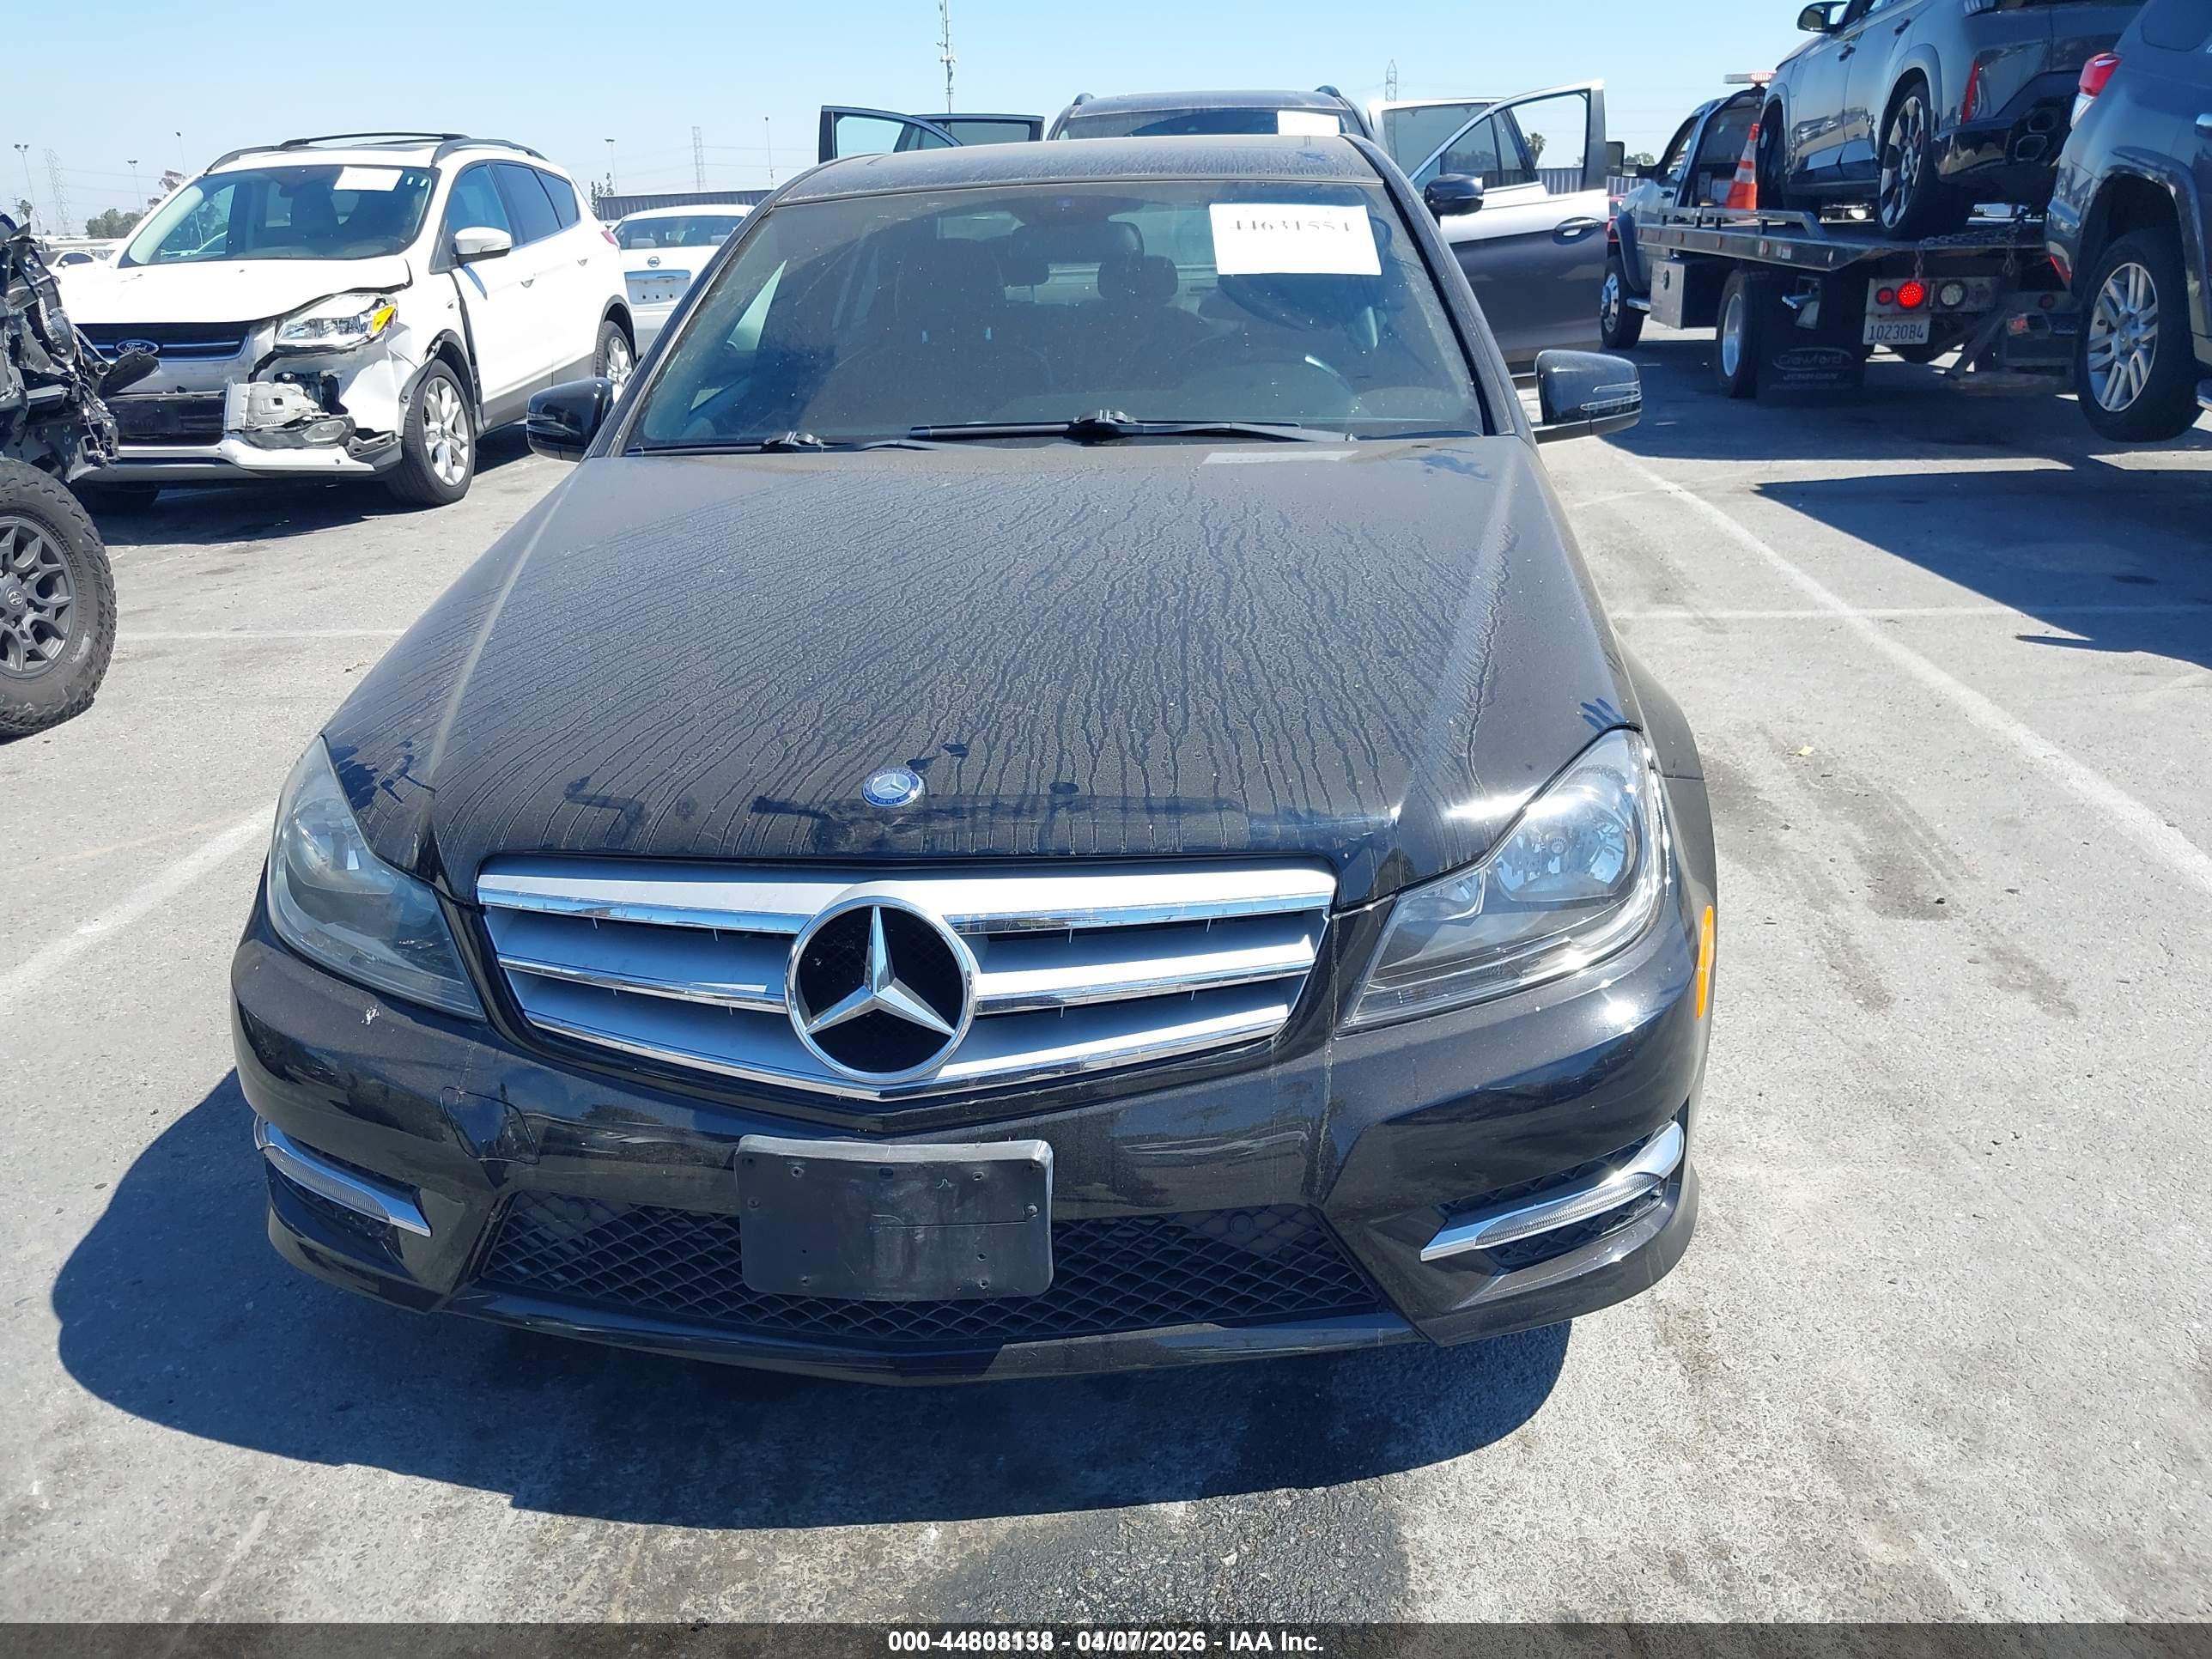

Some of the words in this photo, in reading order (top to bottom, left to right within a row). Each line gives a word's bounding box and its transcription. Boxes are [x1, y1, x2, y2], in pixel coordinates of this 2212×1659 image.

[1869, 324, 1923, 340] 10230B4
[125, 342, 147, 352] Ford
[1778, 353, 1843, 365] Crawford
